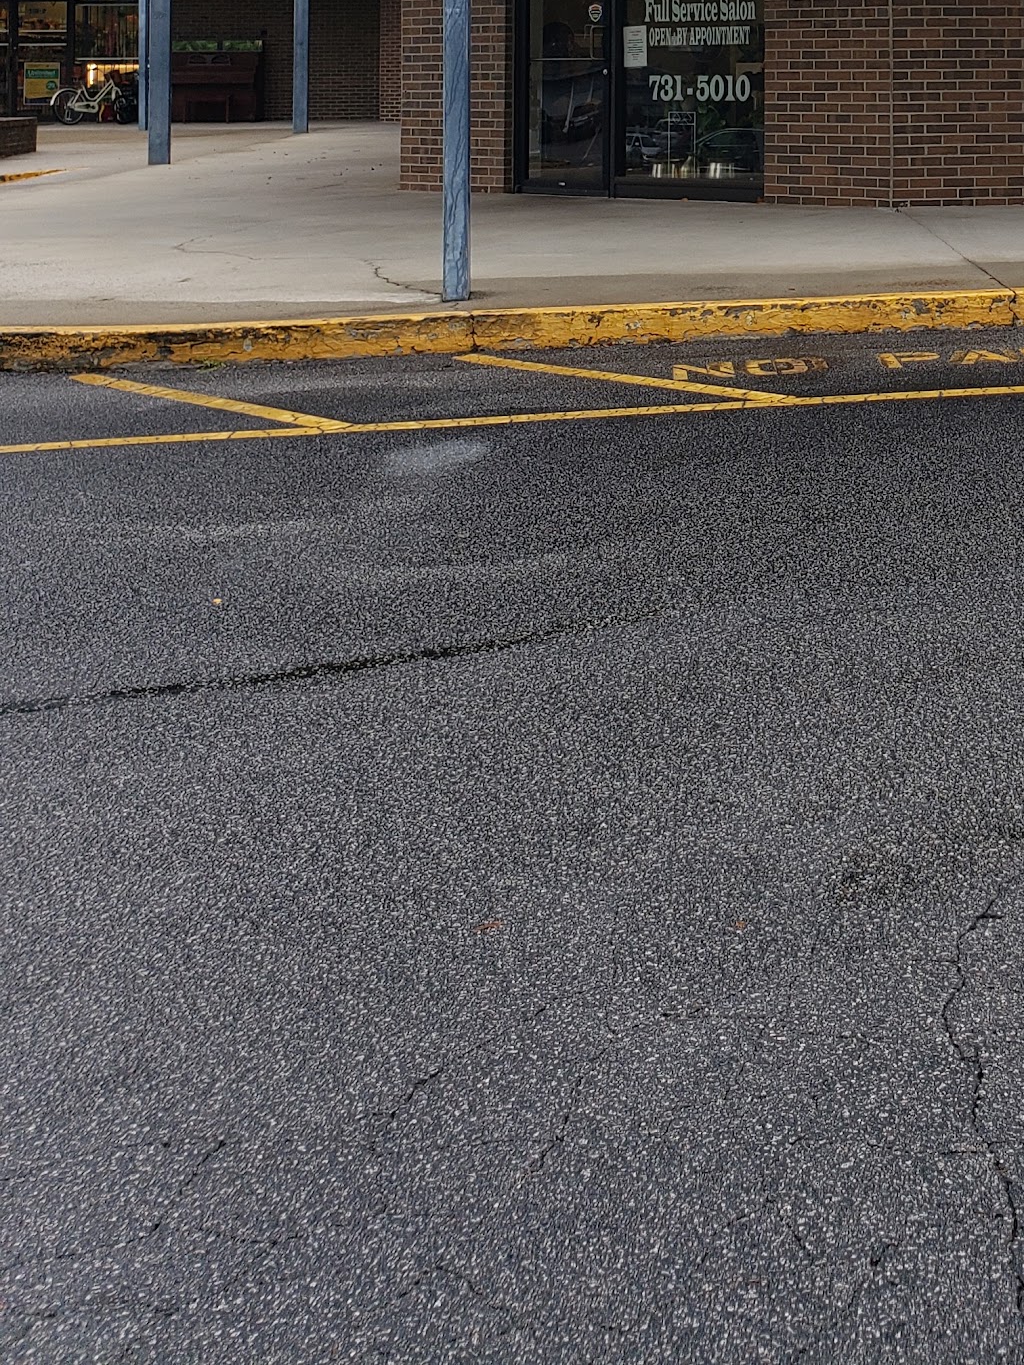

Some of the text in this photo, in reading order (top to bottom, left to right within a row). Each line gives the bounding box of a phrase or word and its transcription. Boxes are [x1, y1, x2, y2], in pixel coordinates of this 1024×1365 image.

[649, 27, 672, 47] OPEN
[676, 27, 688, 46] BY
[689, 25, 750, 46] APPOINTMENT
[649, 74, 751, 101] 731-5010
[672, 357, 820, 381] NO
